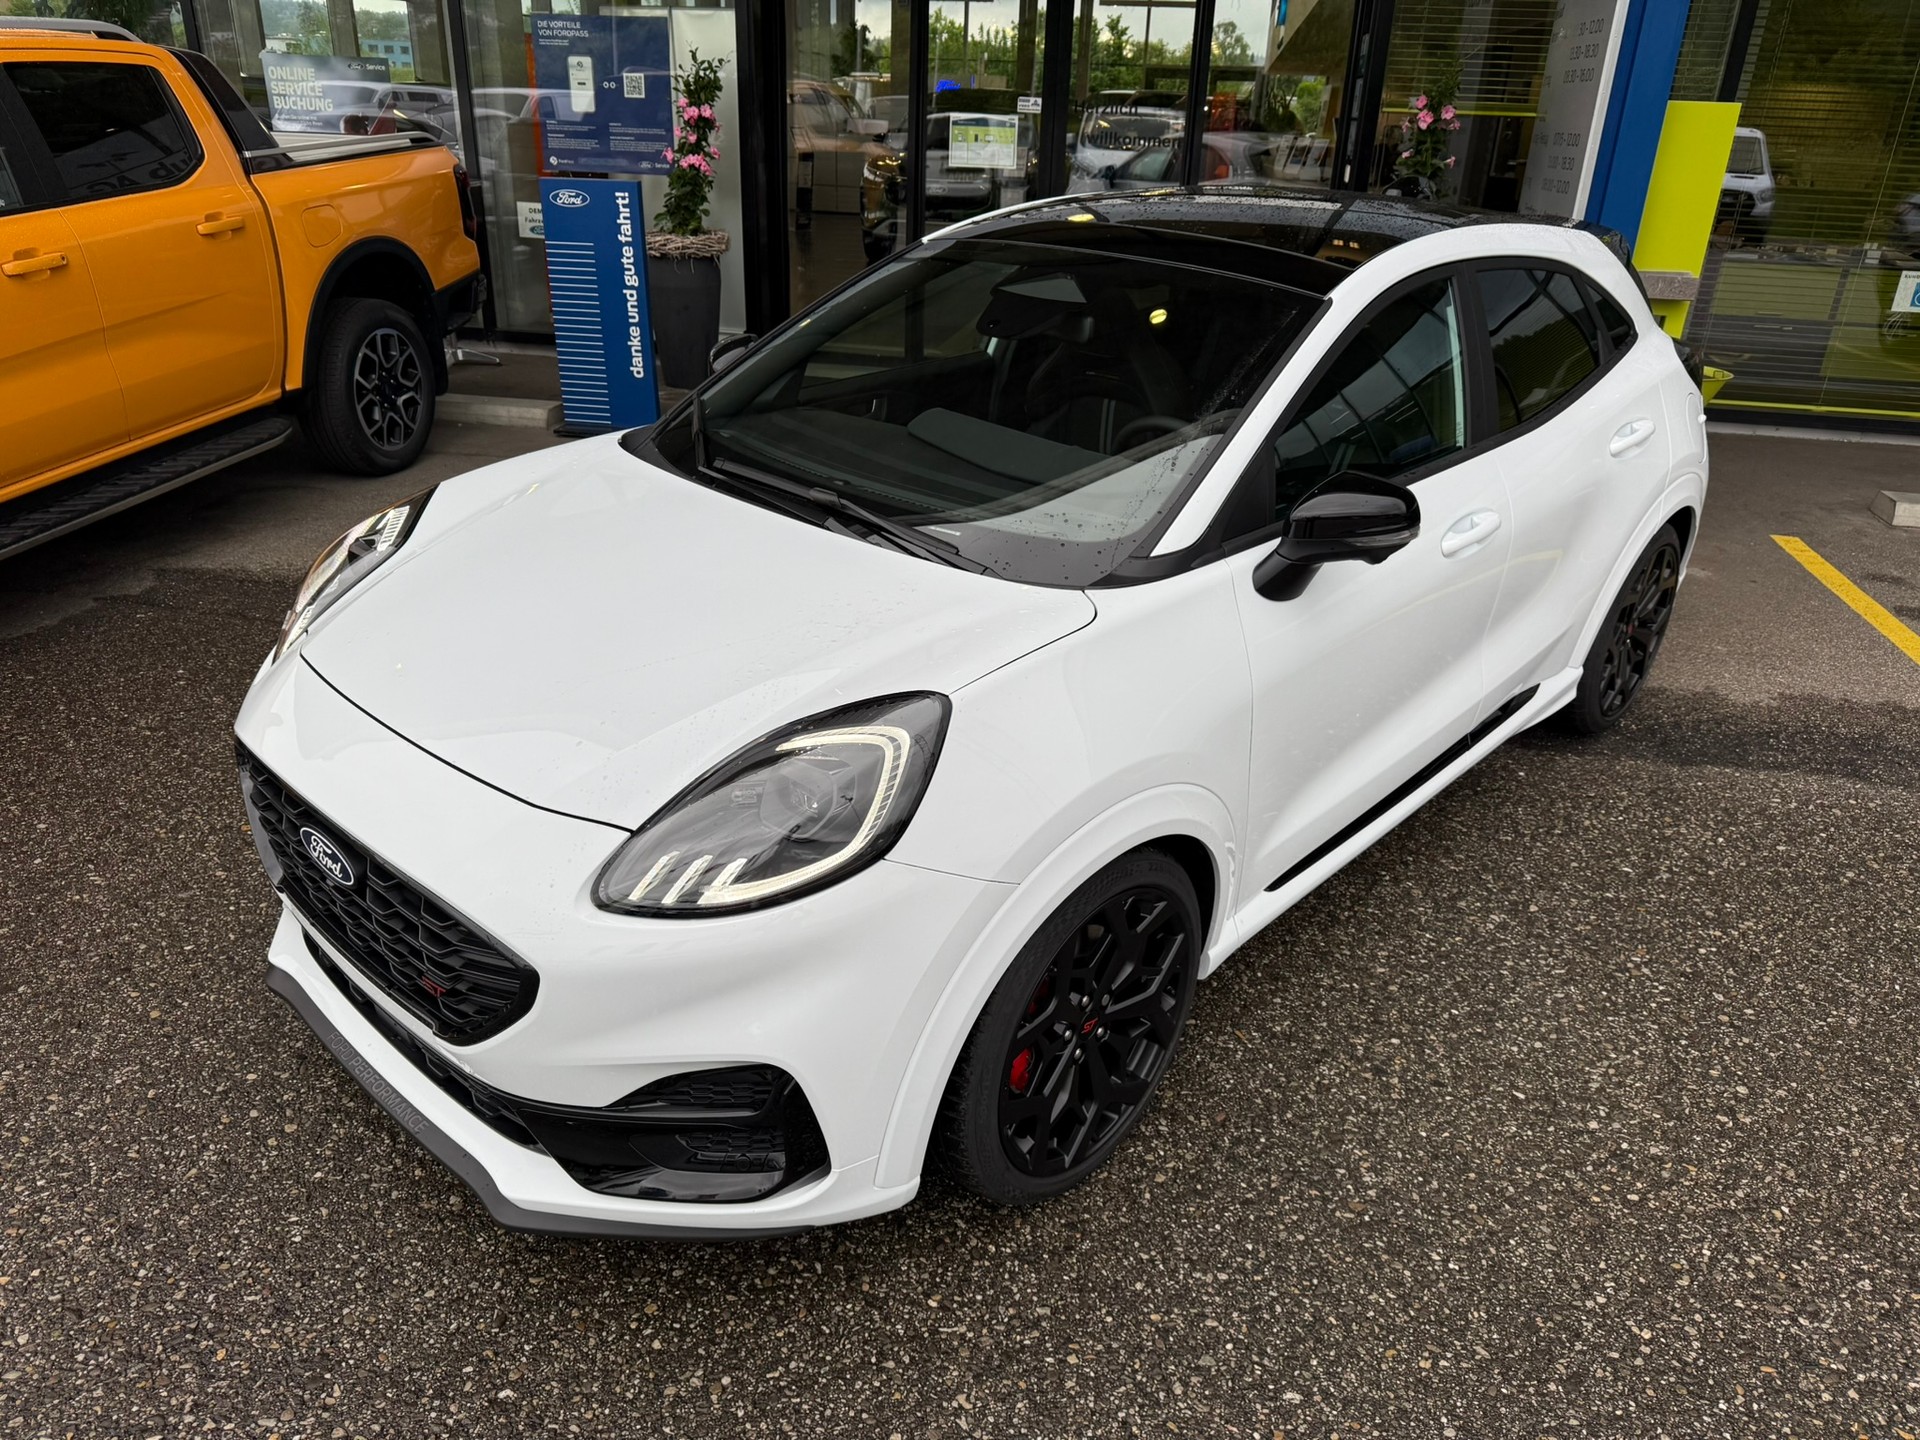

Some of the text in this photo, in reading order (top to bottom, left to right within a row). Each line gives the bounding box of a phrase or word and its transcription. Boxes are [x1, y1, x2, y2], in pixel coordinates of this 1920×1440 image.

[537, 20, 581, 29] DIE VORTEILE
[553, 29, 589, 37] FORDPASS
[268, 66, 315, 80] ONLINE
[365, 63, 386, 71] Service
[271, 81, 323, 96] SERVICE
[273, 96, 333, 111] BUCHUNG
[1073, 101, 1138, 114] Herzlich
[1086, 130, 1180, 148] willkommen
[556, 190, 583, 205] Ford
[615, 191, 644, 378] danke und gute fahrt!
[309, 834, 345, 879] Ford
[1080, 1017, 1099, 1034] ST
[327, 1031, 430, 1135] FORD PERFORMANCE
